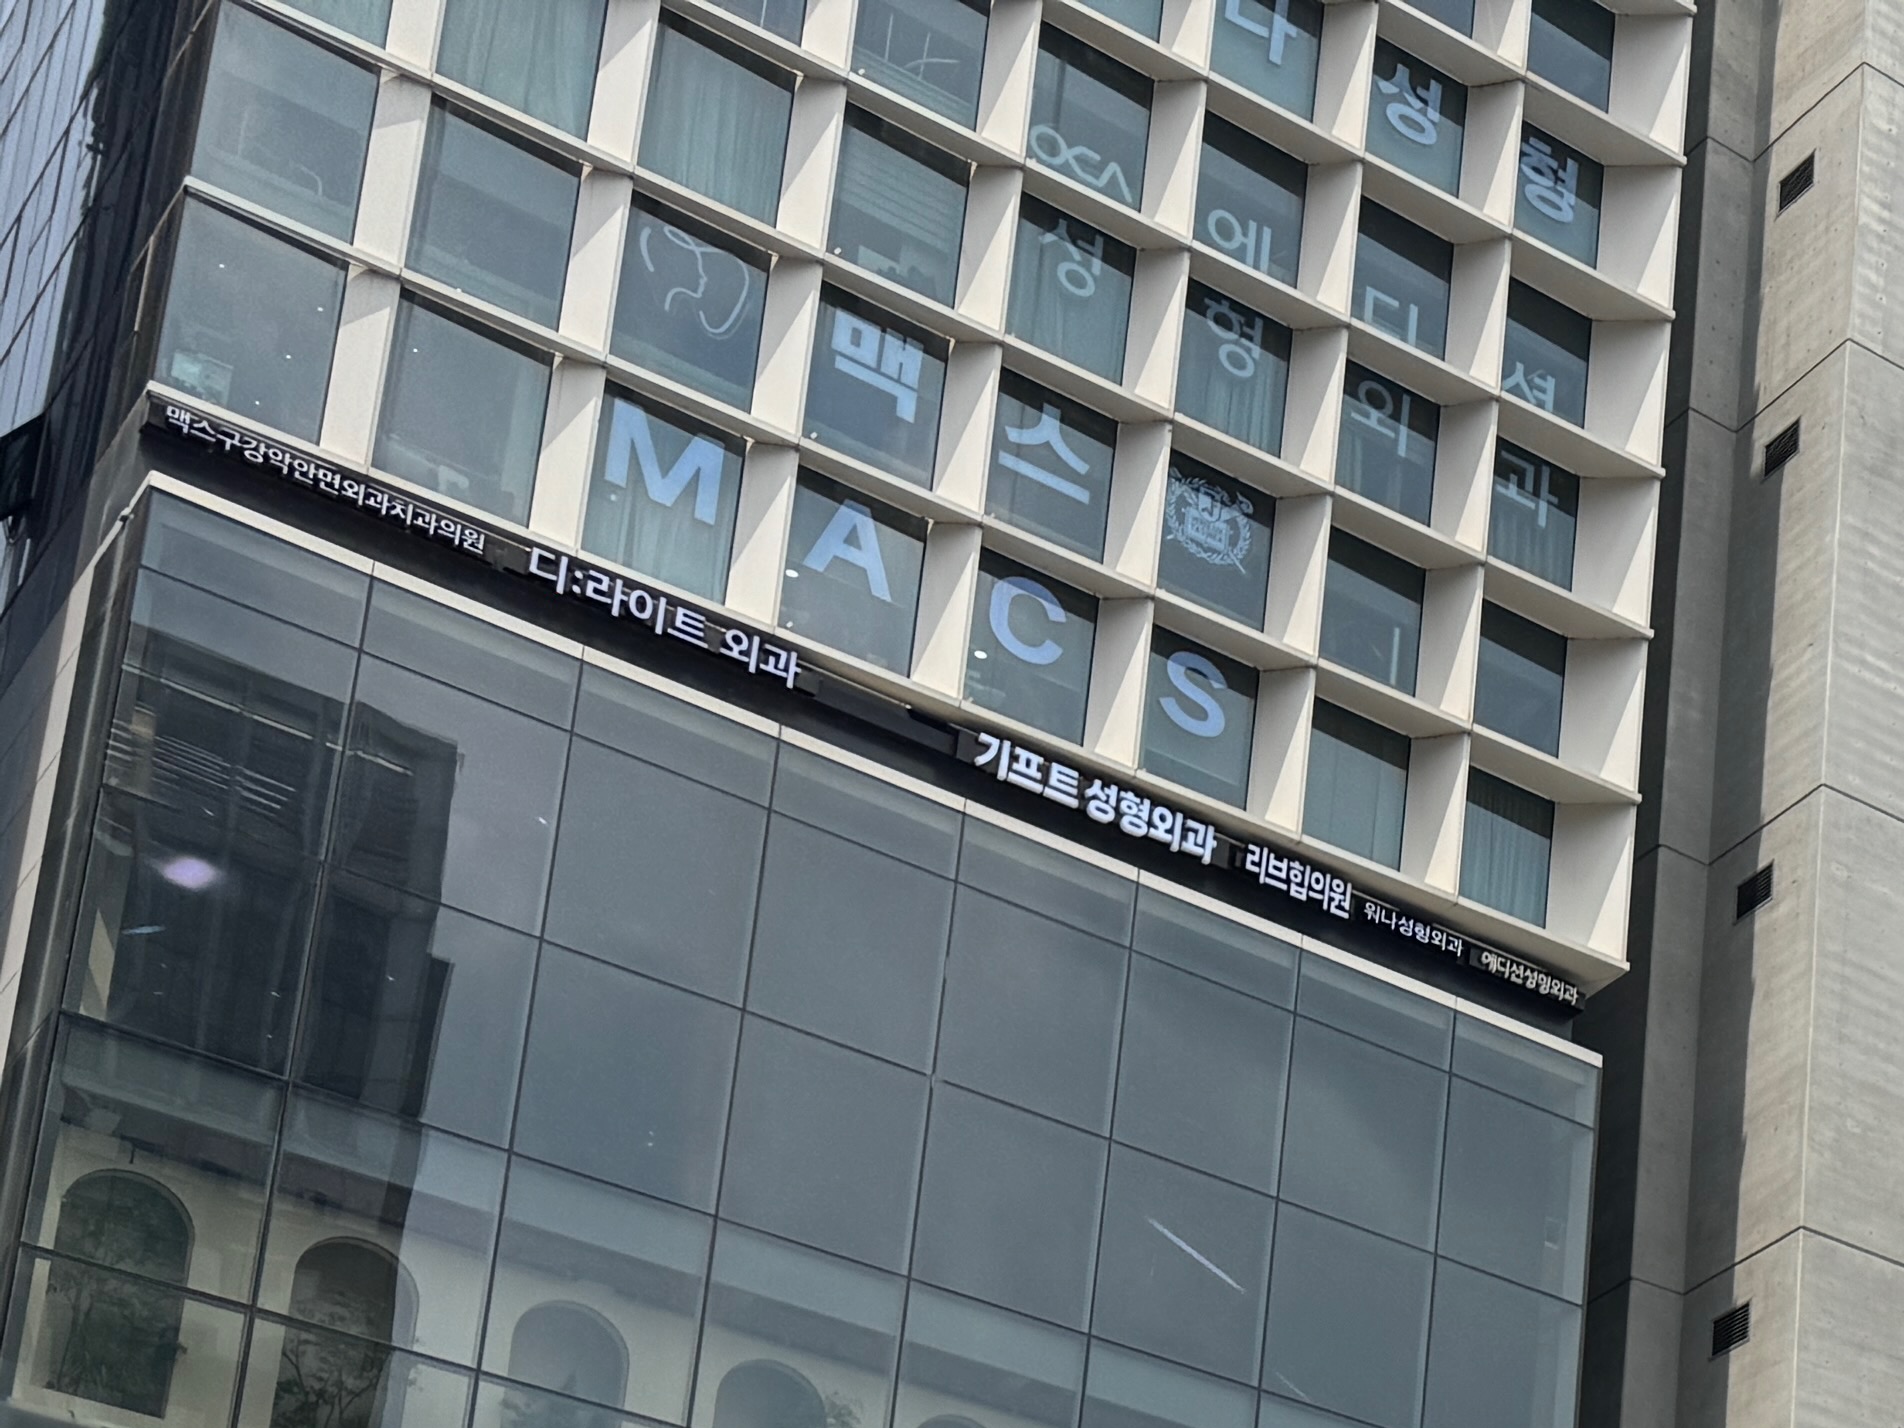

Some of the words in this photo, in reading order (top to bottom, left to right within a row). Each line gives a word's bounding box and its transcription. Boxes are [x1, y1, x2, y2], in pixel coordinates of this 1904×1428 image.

[831, 313, 1090, 505] 맥스
[527, 547, 710, 648] 디:라이트
[719, 627, 804, 690] 외과
[604, 396, 1226, 738] MACS
[973, 731, 1080, 808] 기프트
[1084, 778, 1217, 865] 성형외과
